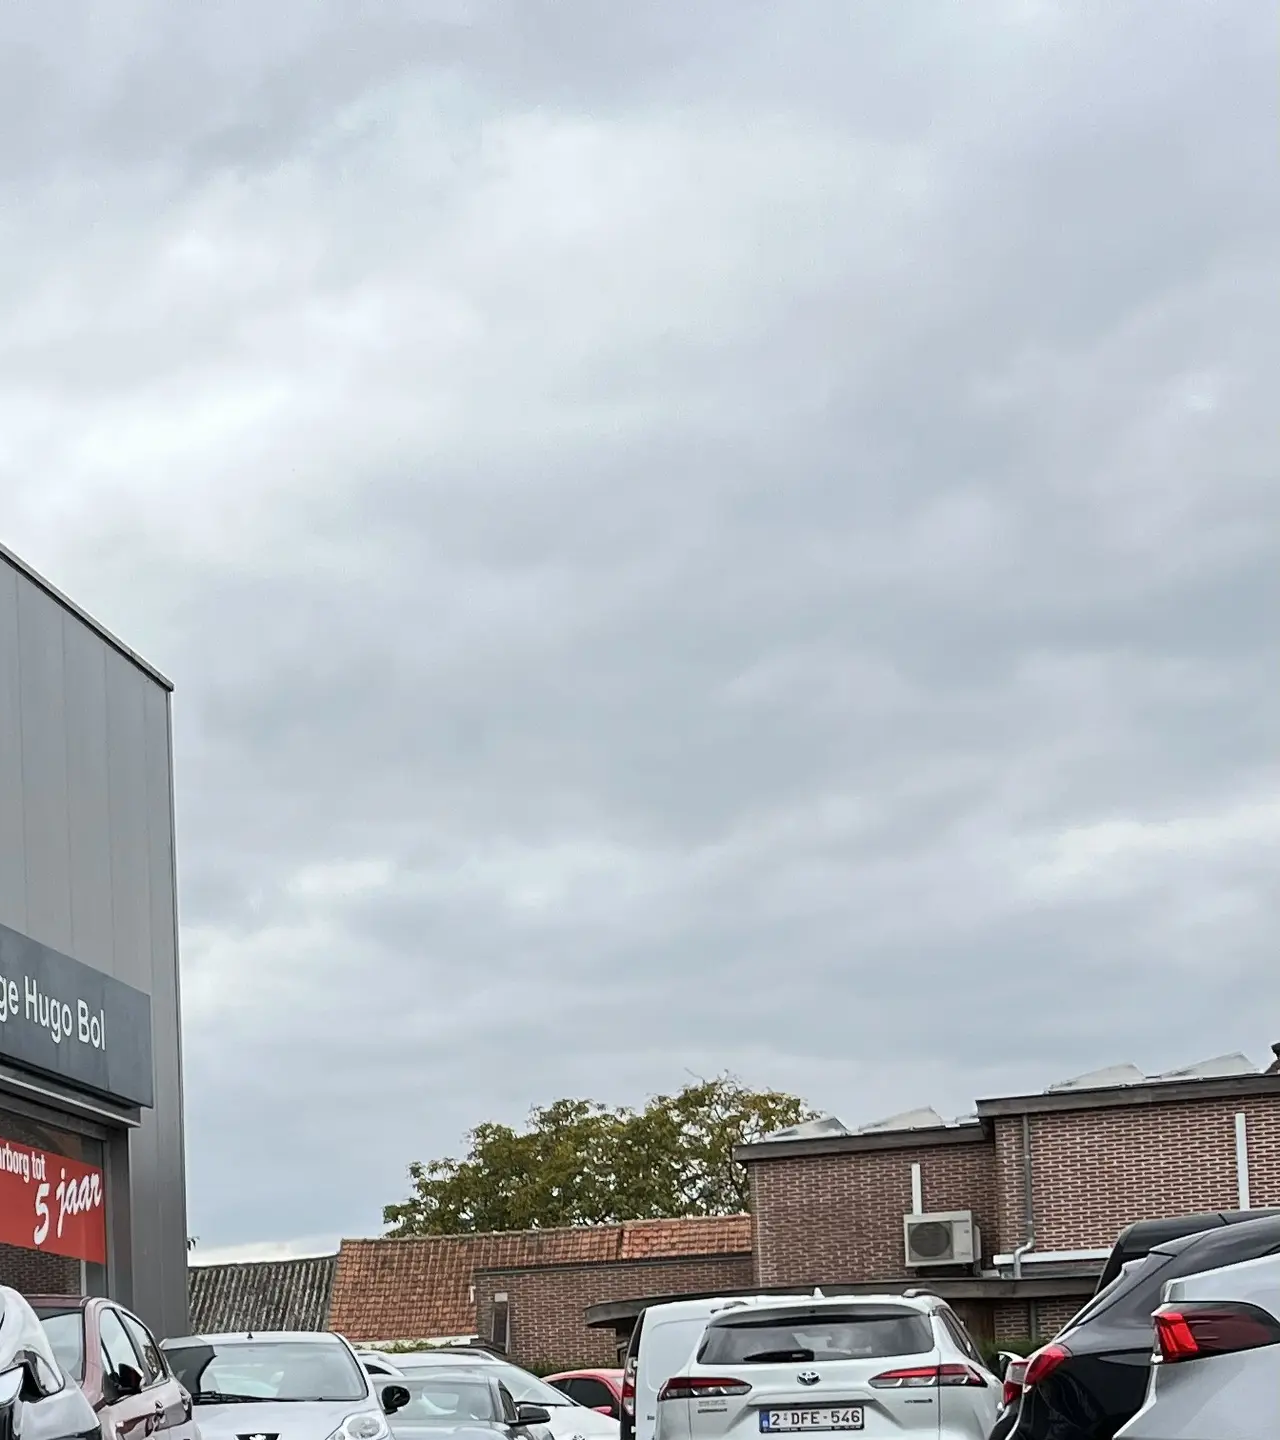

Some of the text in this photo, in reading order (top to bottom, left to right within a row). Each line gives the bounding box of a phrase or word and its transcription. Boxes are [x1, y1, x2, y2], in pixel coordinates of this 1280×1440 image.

[25, 976, 72, 1044] Hugo
[78, 999, 106, 1050] Bol
[32, 1151, 46, 1181] tot
[33, 1167, 102, 1245] 5 jaar
